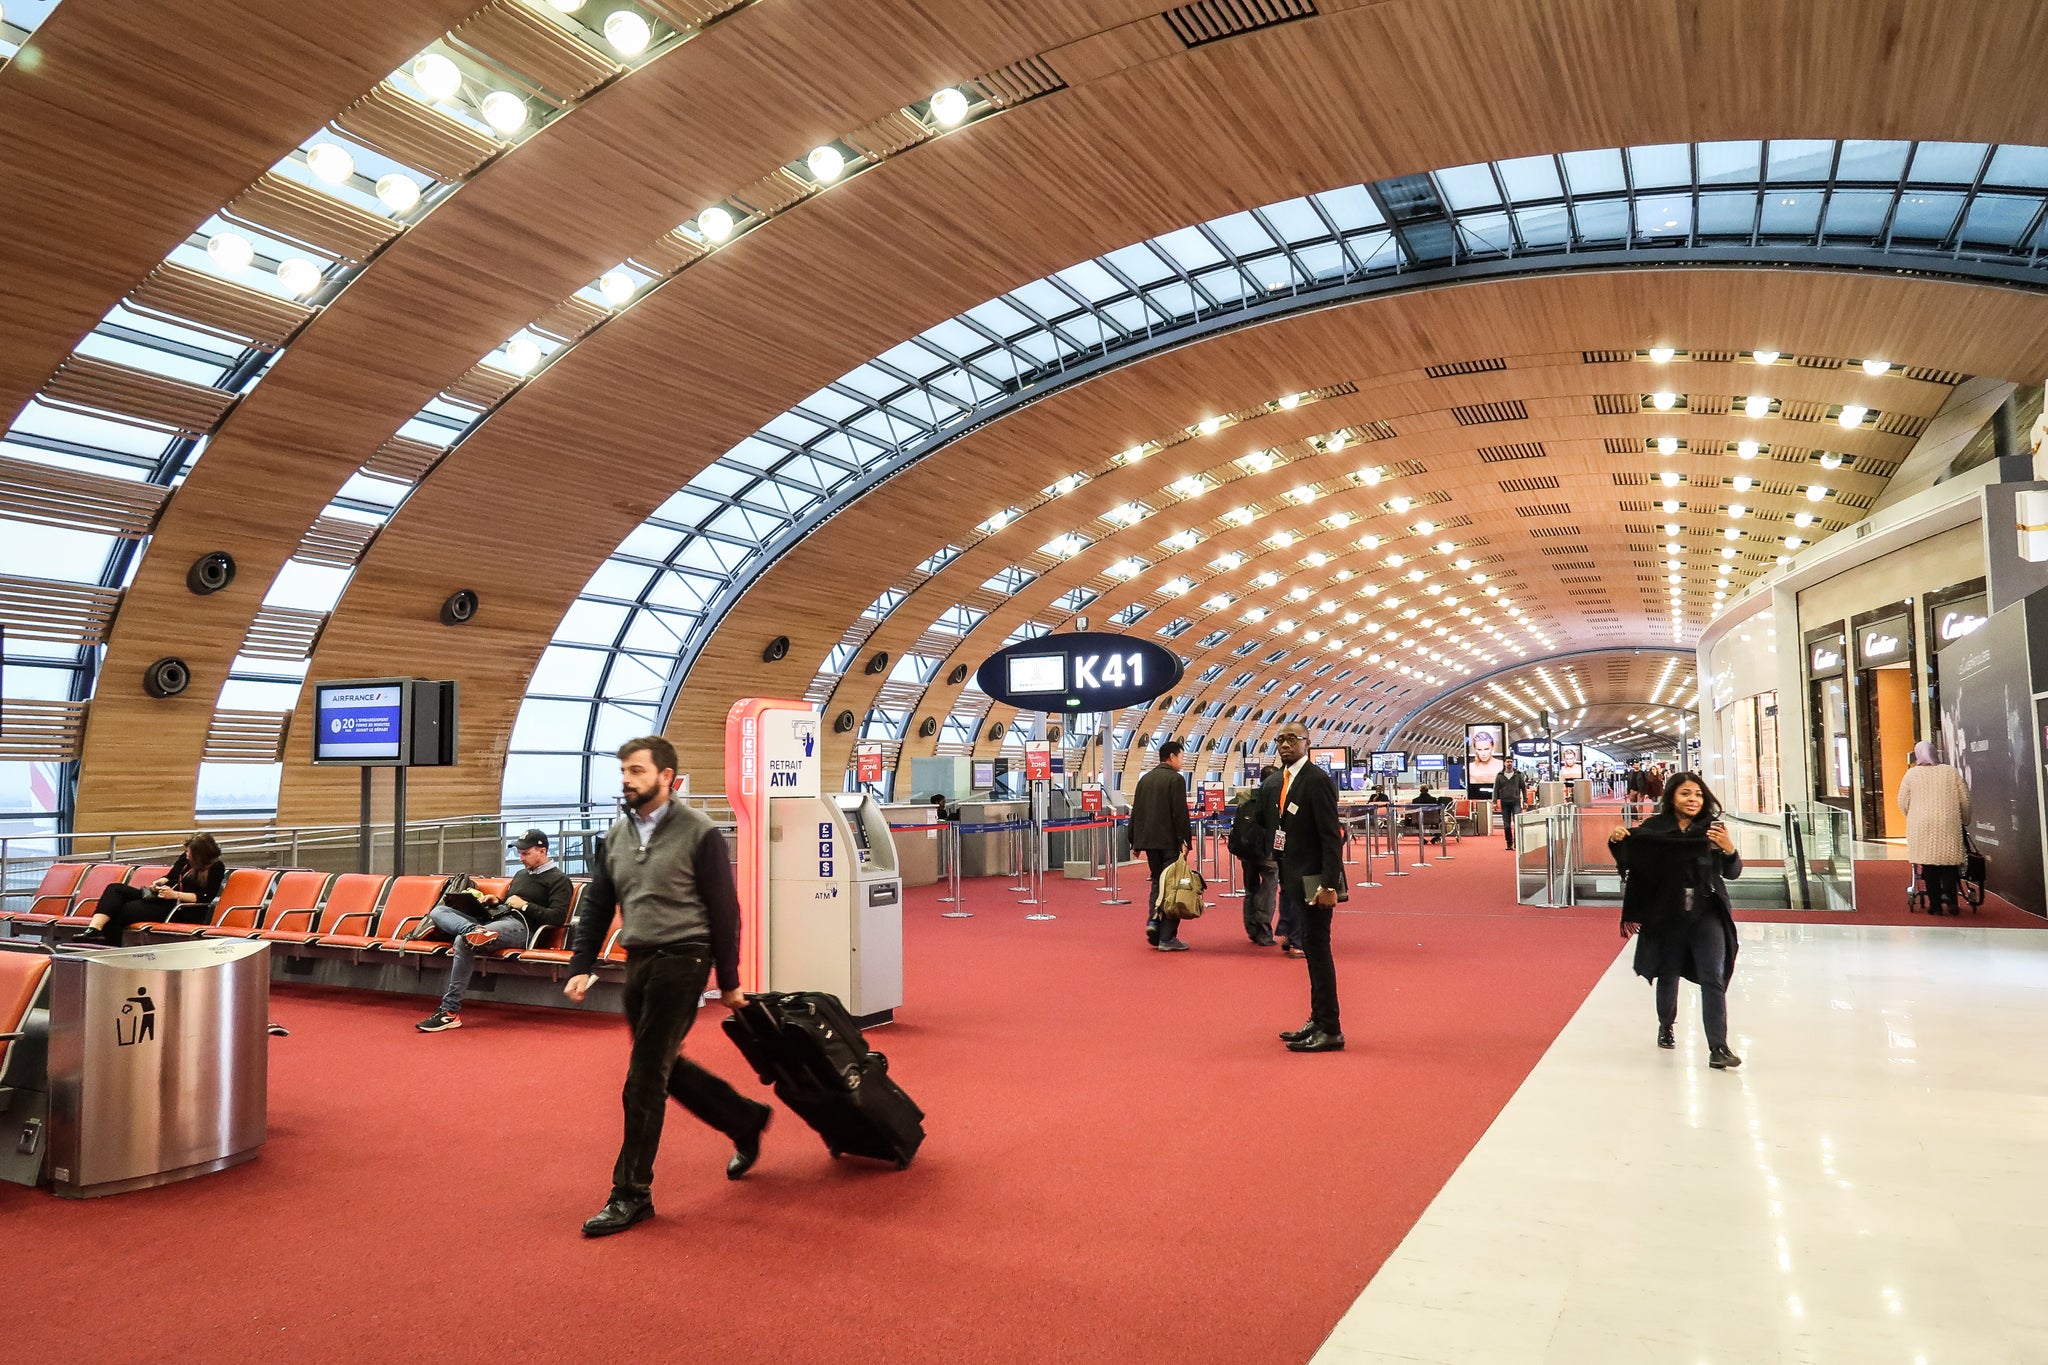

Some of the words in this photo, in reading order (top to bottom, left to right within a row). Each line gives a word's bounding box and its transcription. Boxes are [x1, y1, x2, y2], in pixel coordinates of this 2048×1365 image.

[1864, 632, 1899, 657] Cartier
[1075, 652, 1143, 689] K41
[342, 718, 355, 729] 20
[770, 760, 802, 771] RETRAIT
[867, 770, 873, 780] 1
[1035, 768, 1042, 778] 2
[770, 772, 797, 787] ATM
[815, 892, 831, 900] ATM
